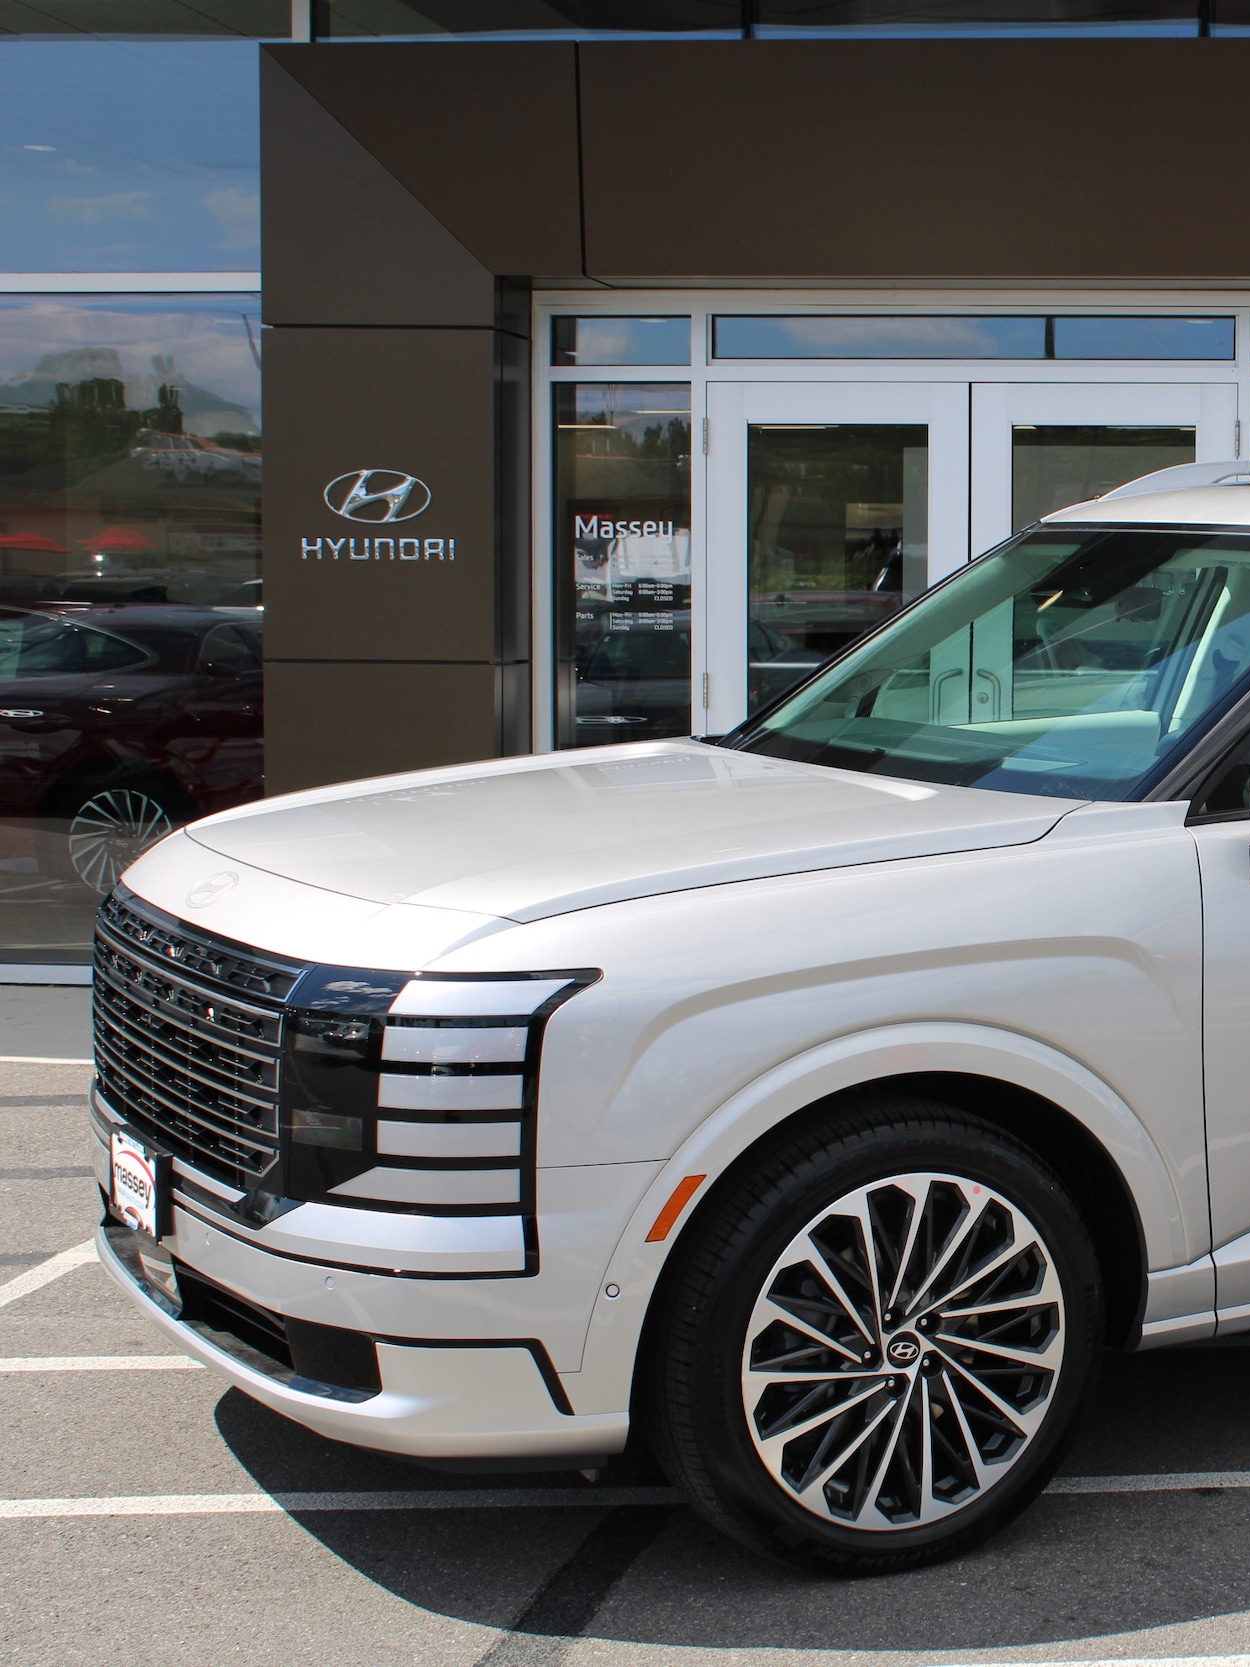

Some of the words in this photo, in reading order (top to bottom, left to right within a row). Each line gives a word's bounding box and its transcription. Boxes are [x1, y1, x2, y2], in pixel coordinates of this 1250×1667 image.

[575, 515, 673, 545] Massey
[301, 537, 455, 561] HYUNDAI
[576, 612, 594, 620] Parts
[115, 1162, 152, 1209] massey
